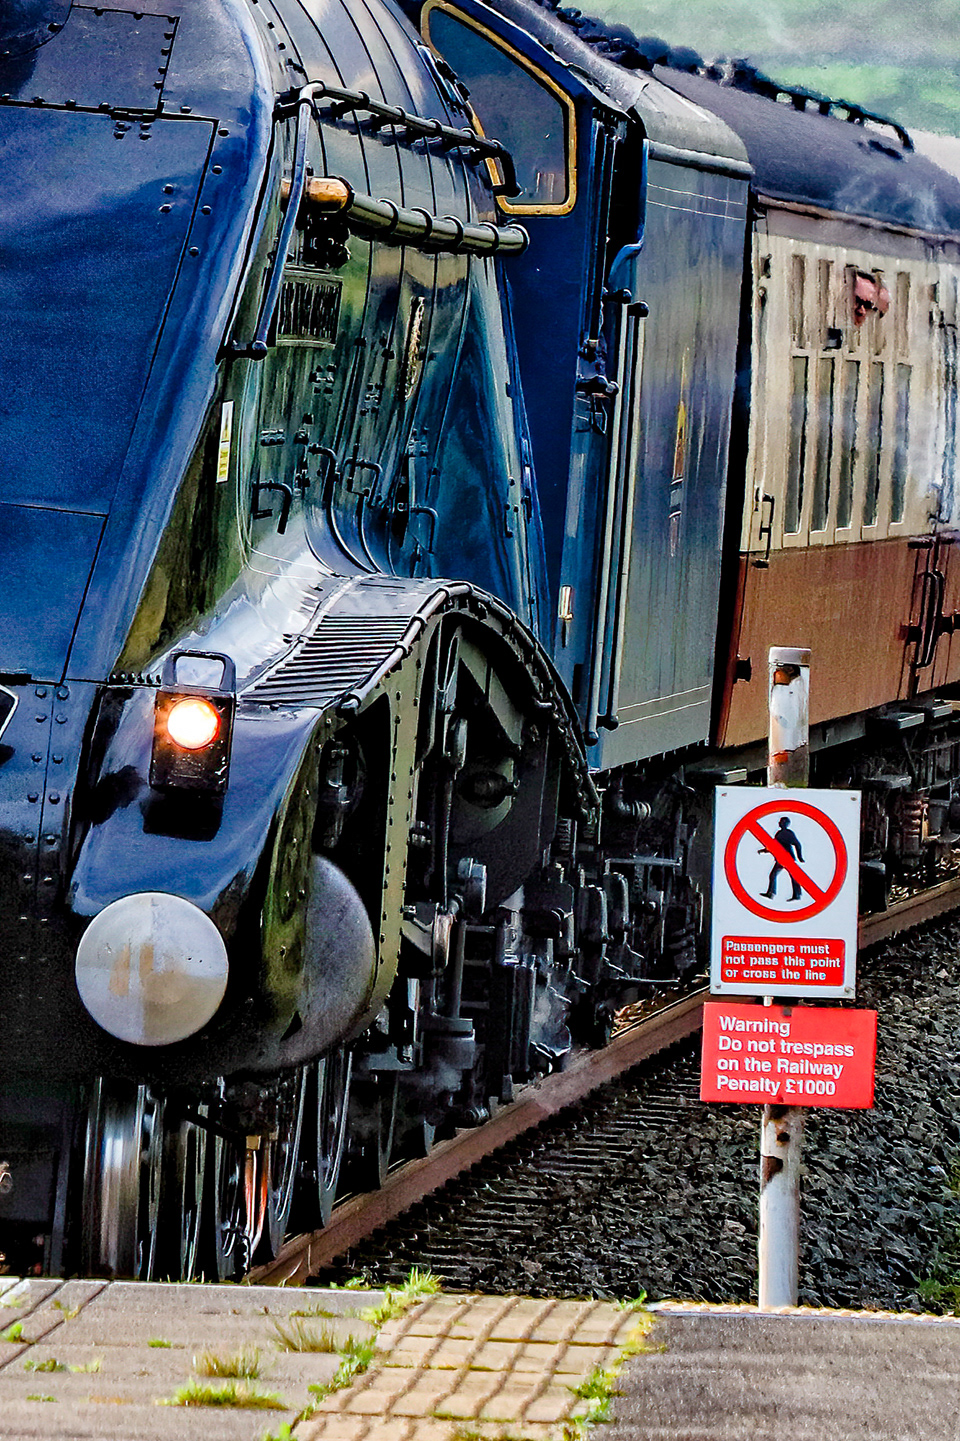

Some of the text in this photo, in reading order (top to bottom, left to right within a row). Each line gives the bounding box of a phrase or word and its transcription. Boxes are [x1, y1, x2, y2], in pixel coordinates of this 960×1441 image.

[726, 940, 830, 955] Passengers must
[725, 954, 841, 968] not pass this point
[725, 968, 827, 980] or cross the line
[719, 1015, 791, 1037] Warning
[718, 1035, 854, 1058] Do not trespass
[717, 1057, 844, 1080] on the Railway
[717, 1074, 836, 1096] Penalty £1000
